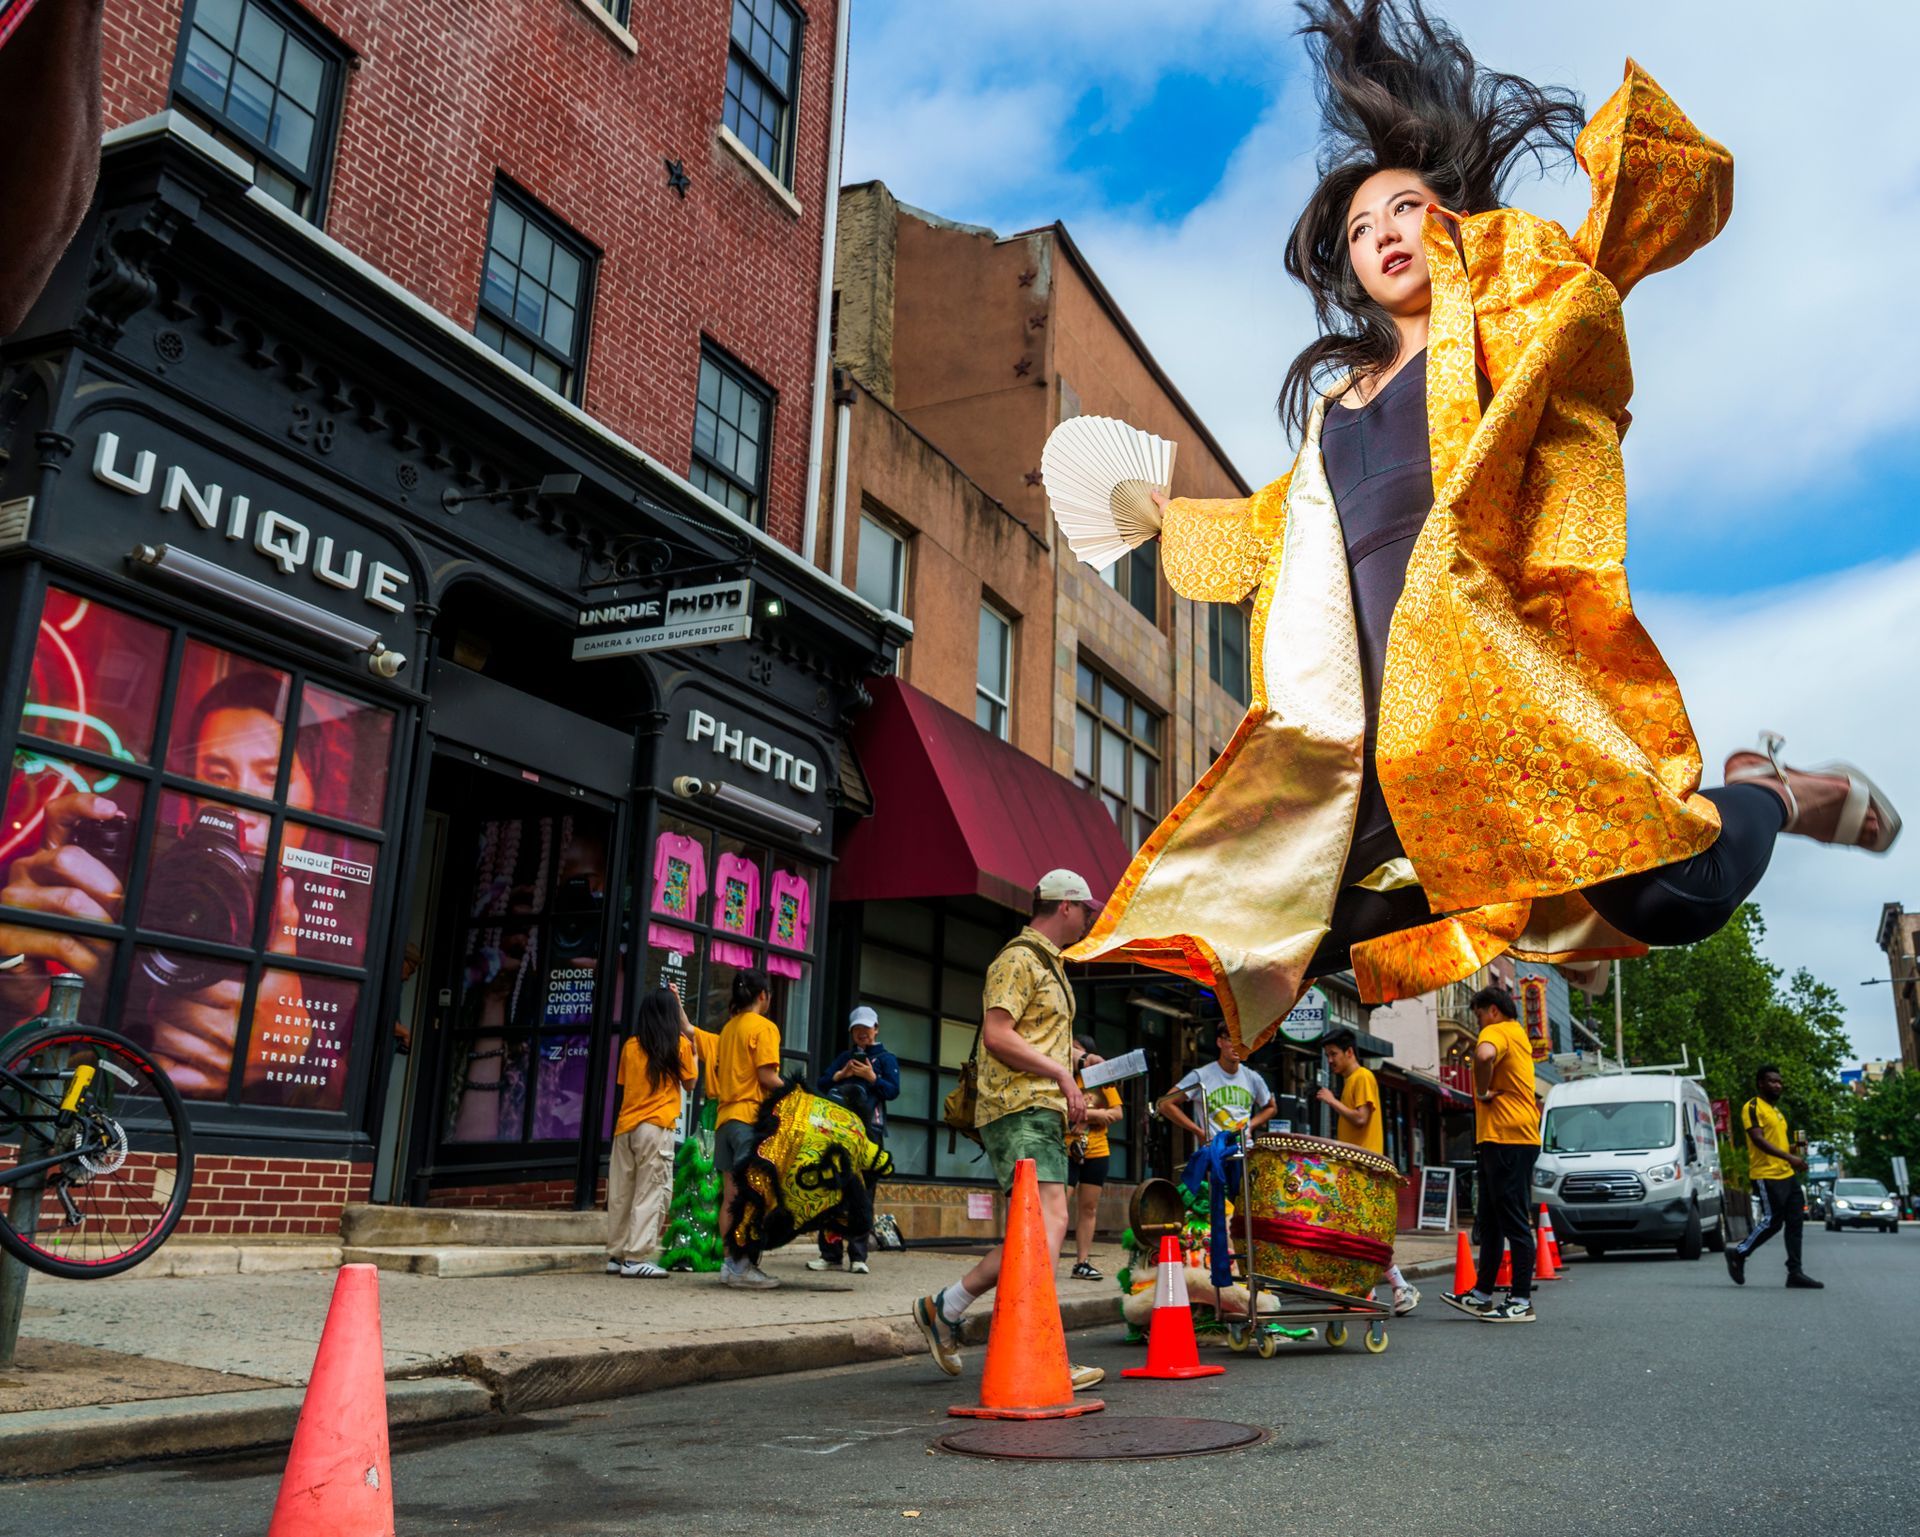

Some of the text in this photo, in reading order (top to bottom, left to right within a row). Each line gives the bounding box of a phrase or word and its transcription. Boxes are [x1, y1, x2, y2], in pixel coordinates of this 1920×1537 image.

[287, 403, 337, 455] 28
[93, 432, 410, 613] UNIQUE
[579, 589, 742, 626] UNIQUE PHOTO
[584, 623, 735, 651] CAMERA & VIDEO SUPERSTORE
[749, 652, 772, 686] 28
[686, 709, 817, 793] PHOTO
[200, 815, 234, 830] Nikon
[287, 853, 369, 878] UNIQUE PHOTO
[304, 882, 346, 899] CAMERA
[312, 900, 334, 911] AND
[304, 913, 337, 927] VIDEO
[283, 926, 353, 946] SUPERSTORE
[550, 968, 594, 979] CHOOSE
[549, 981, 572, 991] ONE
[278, 995, 338, 1012] CLASSES
[548, 992, 592, 1003] CHOOSE
[547, 1004, 593, 1015] EVERYTH
[275, 1014, 336, 1031] RENTALS
[263, 1031, 341, 1050] PHOTO LAB
[261, 1051, 337, 1068] TRADE-INS
[266, 1071, 327, 1085] REPAIRS
